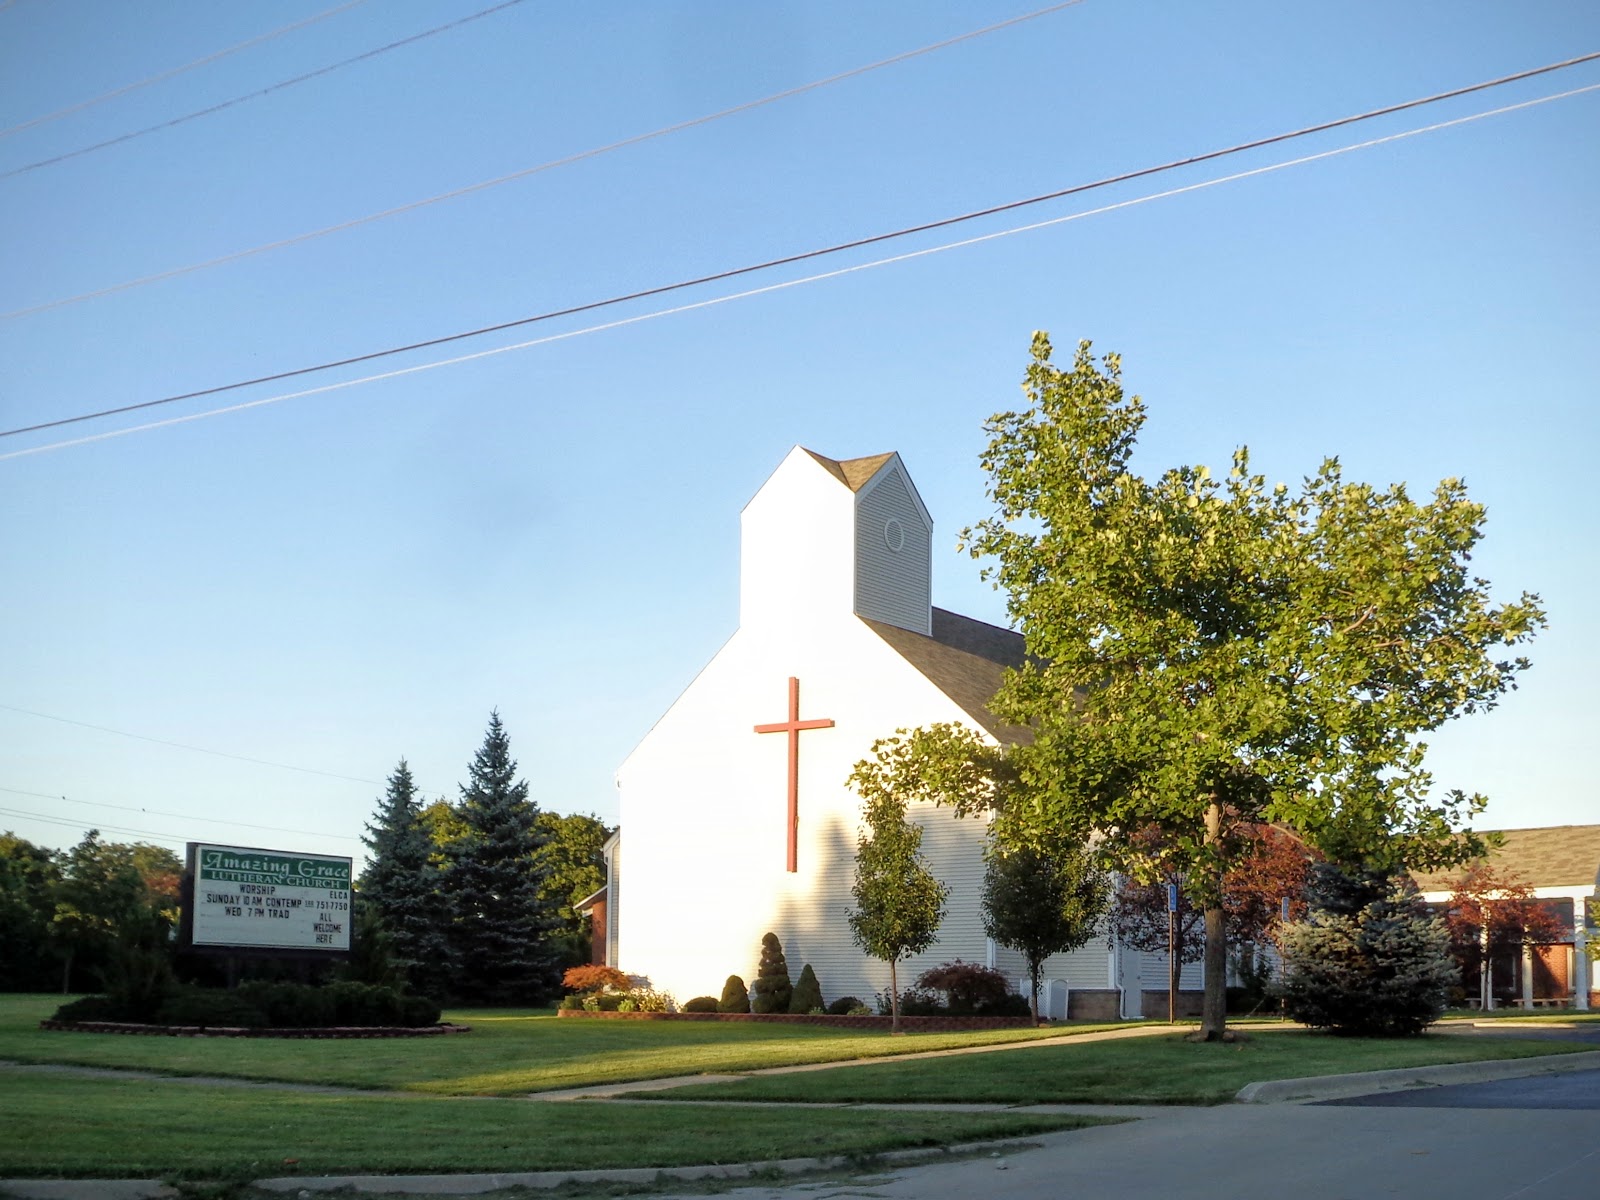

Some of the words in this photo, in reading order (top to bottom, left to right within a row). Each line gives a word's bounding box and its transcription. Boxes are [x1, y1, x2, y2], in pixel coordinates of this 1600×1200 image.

[203, 852, 289, 877] Amazing
[298, 860, 348, 877] Grace
[211, 872, 282, 884] LUTHERAN
[287, 877, 340, 889] CHURCH
[240, 884, 276, 895] WORSHIP
[330, 891, 348, 899] ELCA
[207, 894, 240, 905] SUNDAY
[243, 895, 250, 905] 10
[252, 897, 262, 906] AM
[266, 898, 302, 908] CONTEMP
[225, 907, 242, 916] WED
[248, 908, 253, 917] 7
[254, 909, 264, 917] PM
[268, 909, 290, 919] TRAD
[320, 913, 332, 922] ALL
[313, 923, 342, 933] WELCOME
[316, 934, 333, 944] HERE
